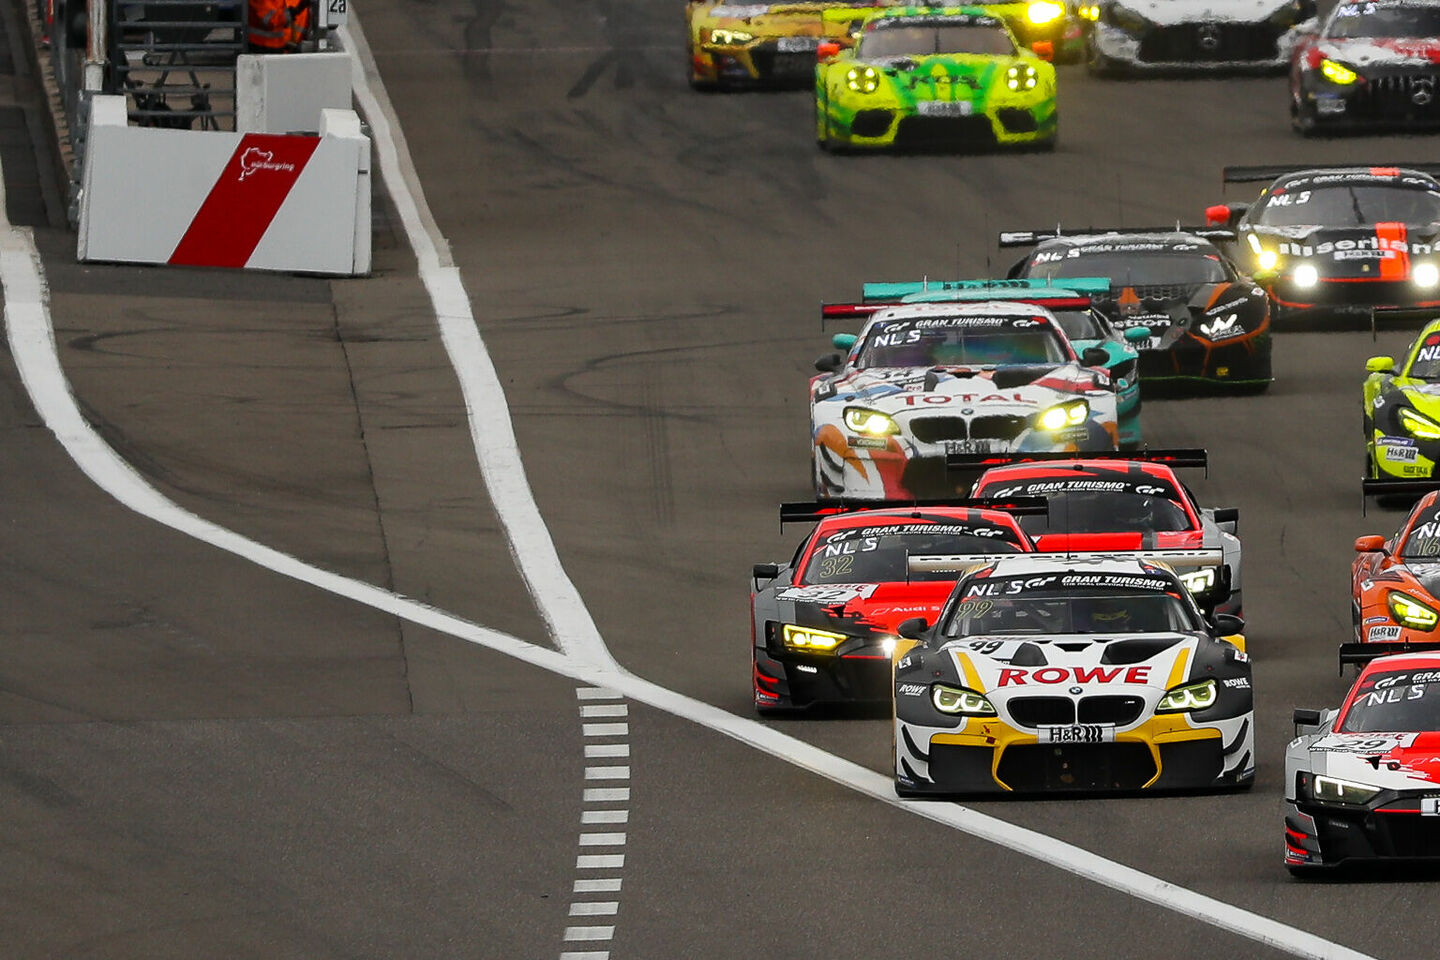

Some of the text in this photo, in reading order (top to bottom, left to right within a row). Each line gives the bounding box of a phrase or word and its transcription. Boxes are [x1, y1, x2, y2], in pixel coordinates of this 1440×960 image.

[915, 318, 1003, 328] GRAN TURISMO
[896, 393, 1038, 406] TOTAL
[1028, 480, 1126, 492] GRAN TURISMO
[861, 524, 963, 535] GRAN TURISMO
[819, 555, 854, 578] 32
[1061, 575, 1101, 585] GRAN
[1104, 576, 1167, 588] TURISMO
[957, 600, 994, 622] 99
[968, 640, 1006, 654] 99
[998, 666, 1152, 687] ROWE
[1223, 677, 1249, 688] ROWE
[898, 683, 927, 694] ROWE
[1050, 727, 1081, 742] H&R
[1333, 740, 1388, 750] 29
